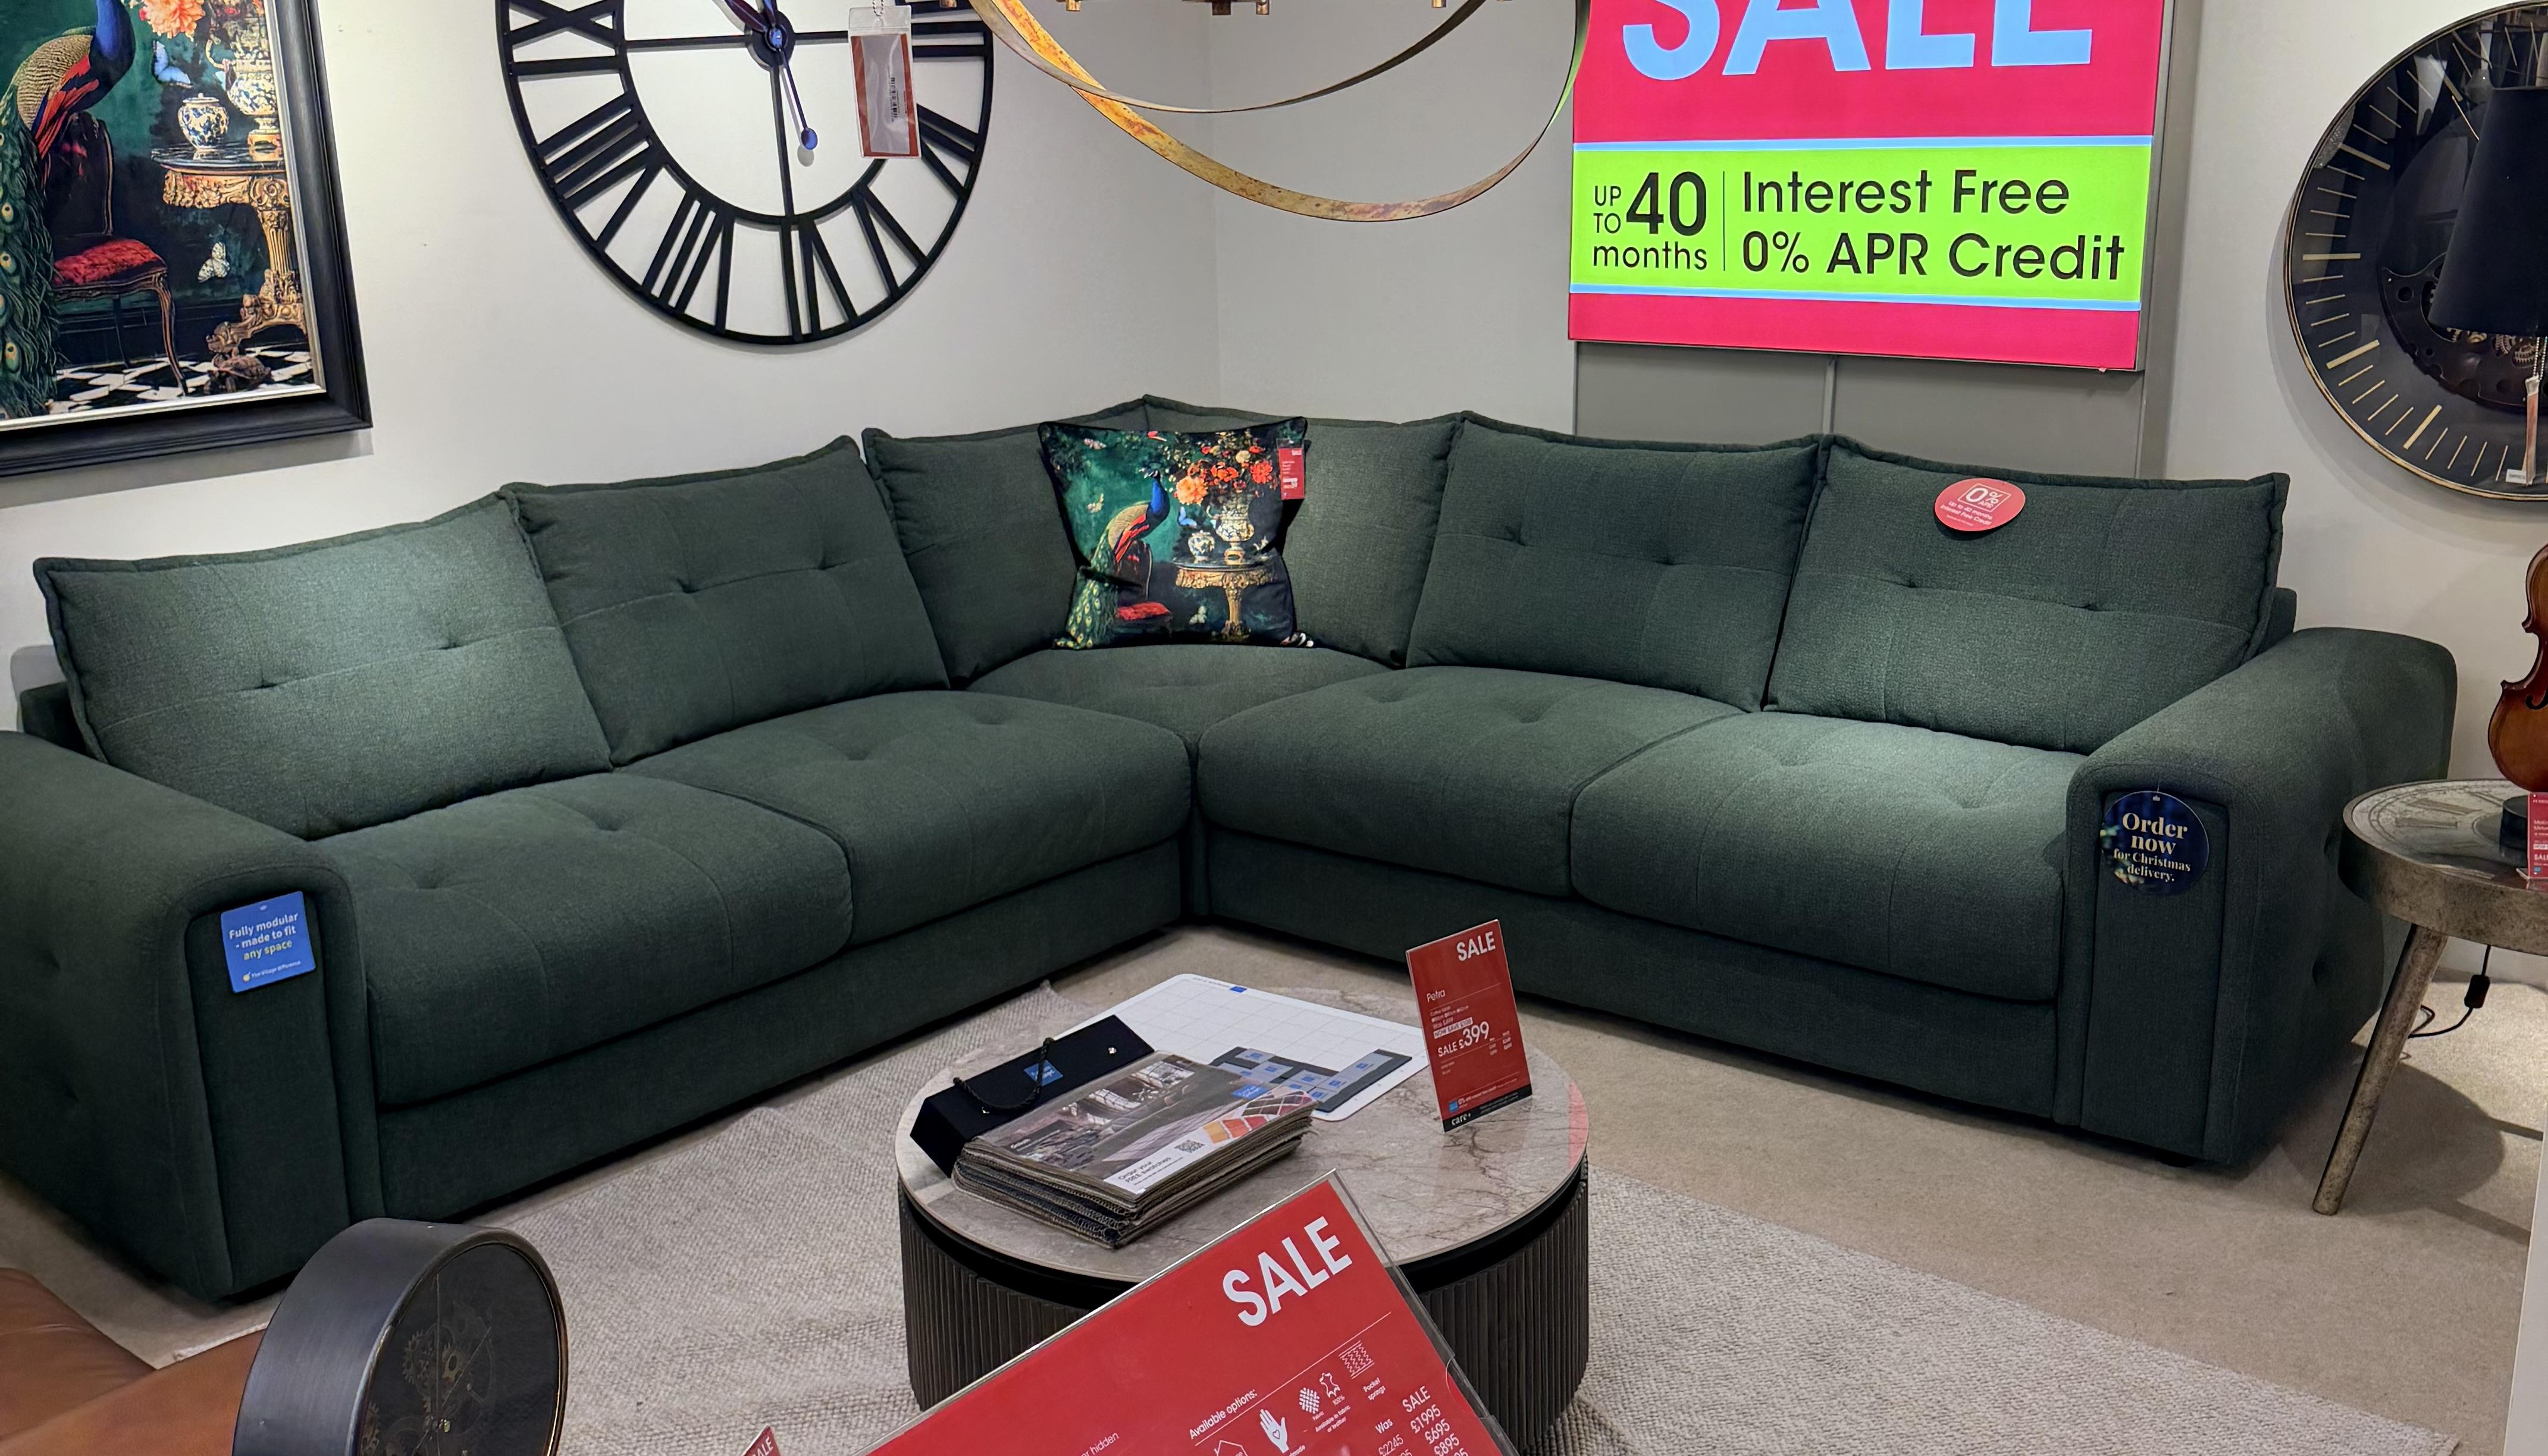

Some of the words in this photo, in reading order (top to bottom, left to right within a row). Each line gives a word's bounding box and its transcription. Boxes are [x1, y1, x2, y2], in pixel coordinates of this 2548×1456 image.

[1594, 185, 1622, 206] UP
[1626, 171, 1707, 237] 40
[1743, 170, 1932, 214] Interest
[1953, 170, 2069, 214] Free
[1593, 212, 1621, 234] TO
[1593, 241, 1707, 271] months
[1743, 231, 1810, 274] 0%
[1826, 233, 1928, 275] APR
[1948, 233, 2125, 280] Credit
[1966, 487, 2002, 504] 0%
[2122, 812, 2188, 839] Order
[2130, 835, 2177, 855] now
[2114, 848, 2131, 860] for
[2132, 852, 2191, 872] Christmas
[2127, 864, 2175, 883] delivery.
[229, 925, 253, 940] Fully
[256, 913, 299, 931] modular
[242, 933, 270, 948] made
[272, 930, 283, 940] to
[284, 925, 297, 936] fit
[243, 948, 262, 961] any
[264, 940, 293, 955] space
[1456, 931, 1496, 961] SALE
[1427, 990, 1446, 1003] Petra
[1437, 1041, 1458, 1058] SALE
[1458, 1021, 1490, 1050] £399
[1223, 1216, 1353, 1326] SALE
[1402, 1385, 1431, 1413] SALE
[1189, 1410, 1227, 1440] Available
[1226, 1389, 1258, 1414] options:
[1375, 1419, 1393, 1434] Was
[1410, 1404, 1441, 1433] £1995
[1090, 1432, 1120, 1455] hidden
[1424, 1418, 1450, 1445] £695
[753, 1435, 774, 1456] ALE
[1378, 1433, 1404, 1456] £2245
[1434, 1433, 1460, 1456] £895
